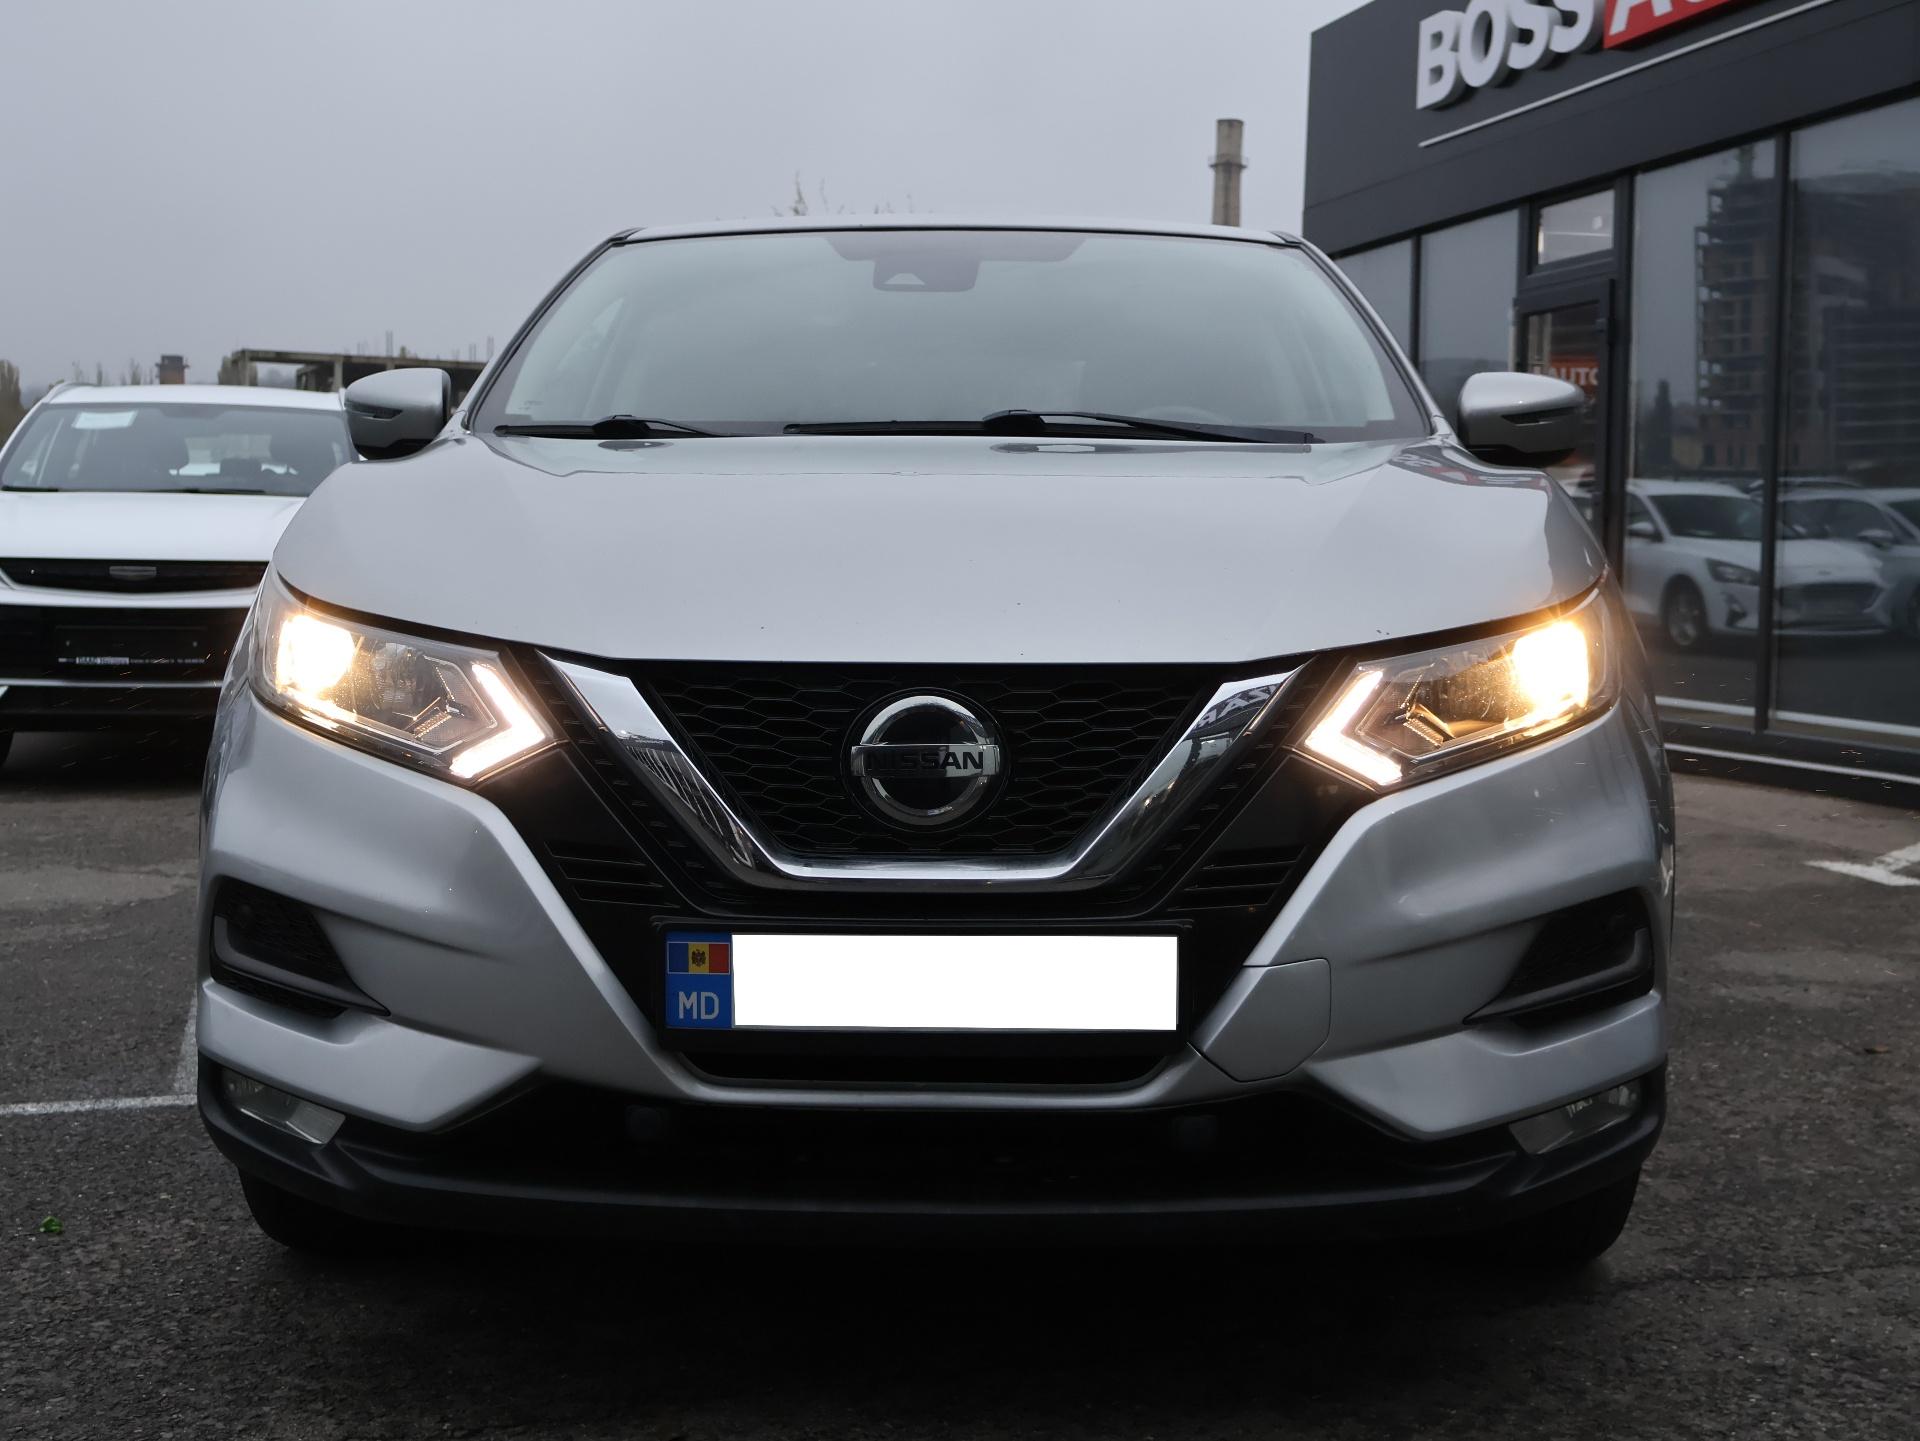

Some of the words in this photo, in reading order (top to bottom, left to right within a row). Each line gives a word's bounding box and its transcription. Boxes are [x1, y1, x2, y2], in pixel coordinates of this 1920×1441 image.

[1416, 0, 1598, 110] BOSS
[864, 751, 984, 770] NISSAN
[678, 991, 720, 1020] MD
